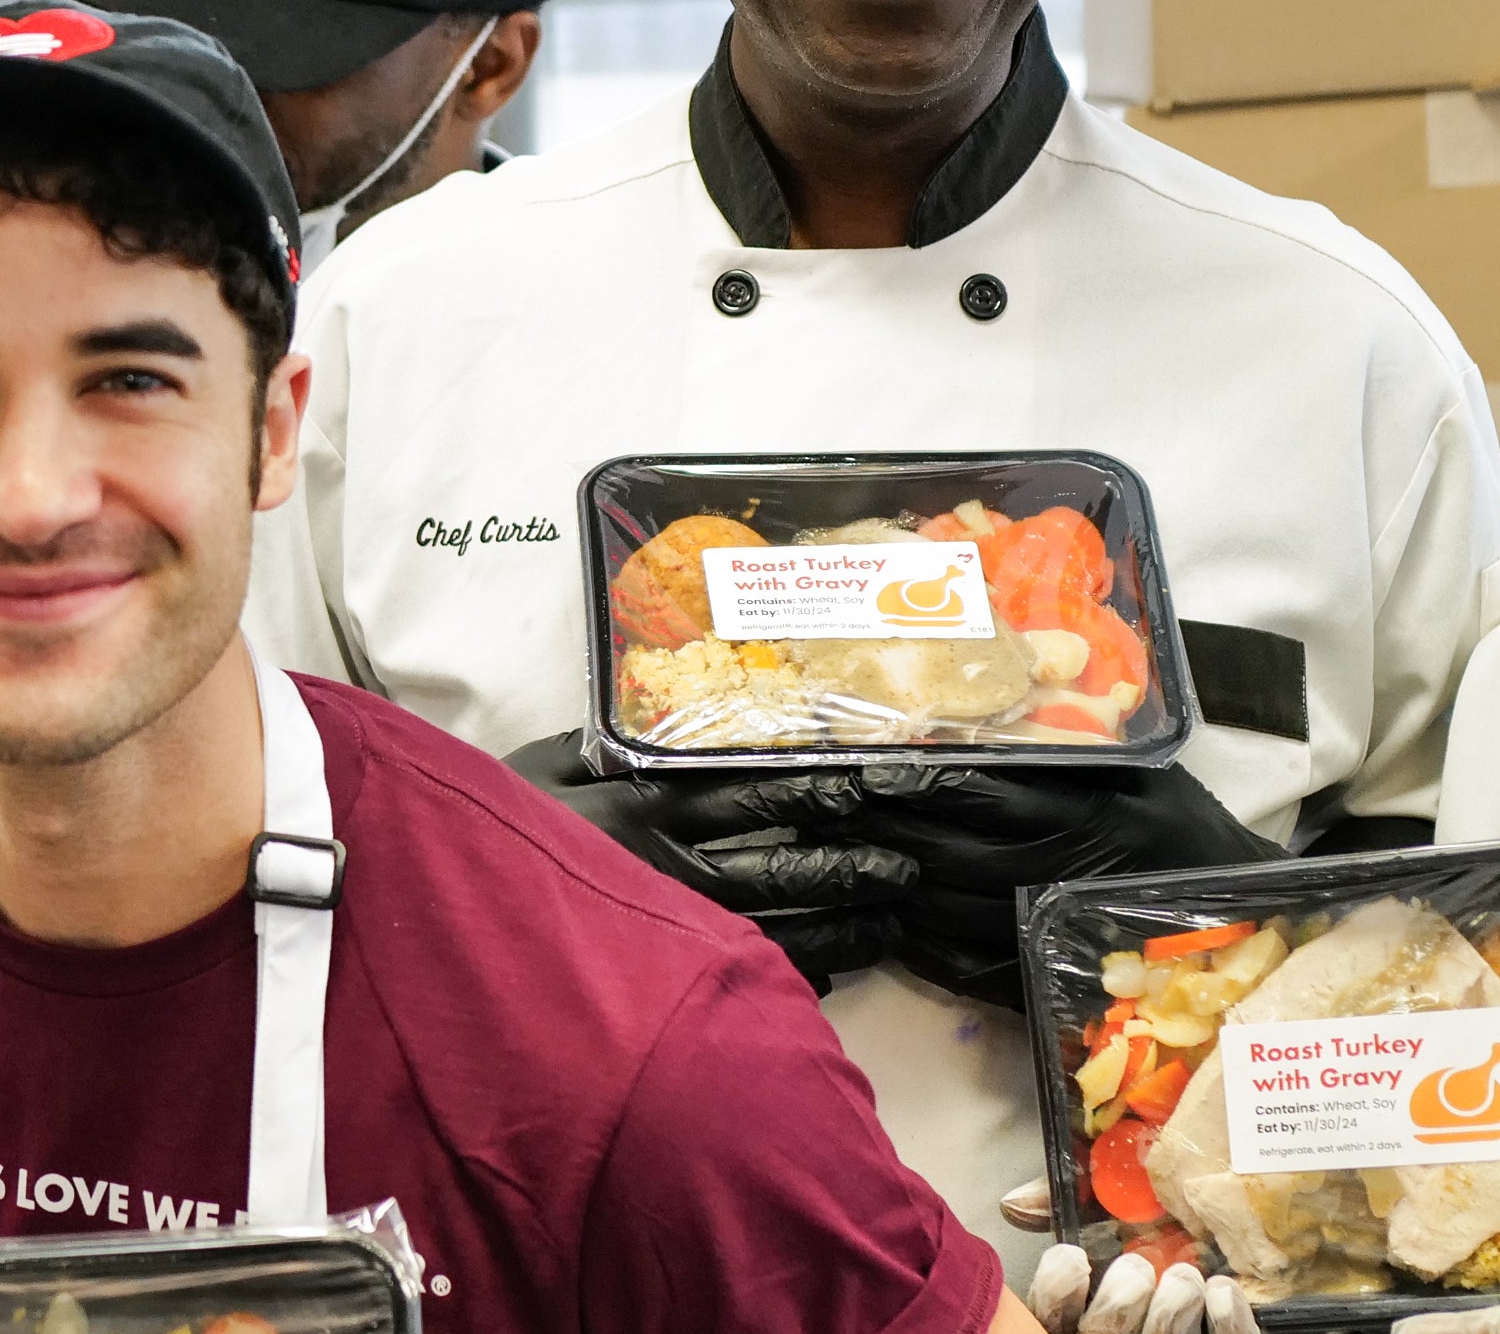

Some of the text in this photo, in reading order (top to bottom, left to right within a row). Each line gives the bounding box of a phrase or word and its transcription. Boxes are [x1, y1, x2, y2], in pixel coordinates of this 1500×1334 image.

[416, 515, 561, 556] Chef Curtis
[731, 555, 887, 573] Roast Turkey
[734, 575, 870, 592] with Gravy
[737, 596, 865, 606] Contains: Wheat, Soy
[760, 609, 780, 618] by:
[782, 606, 831, 616] 11/30/24
[1249, 1033, 1424, 1063] Roast Turkey
[1252, 1068, 1403, 1093] with Gravy
[1255, 1098, 1397, 1116] Contains: Wheat, Soy
[1256, 1117, 1358, 1135] Eat by: 11/30/24
[1317, 1144, 1335, 1154] eat
[1335, 1142, 1367, 1153] within
[1368, 1141, 1375, 1151] 2
[16, 1168, 130, 1225] LOVE
[142, 1190, 221, 1233] WE
